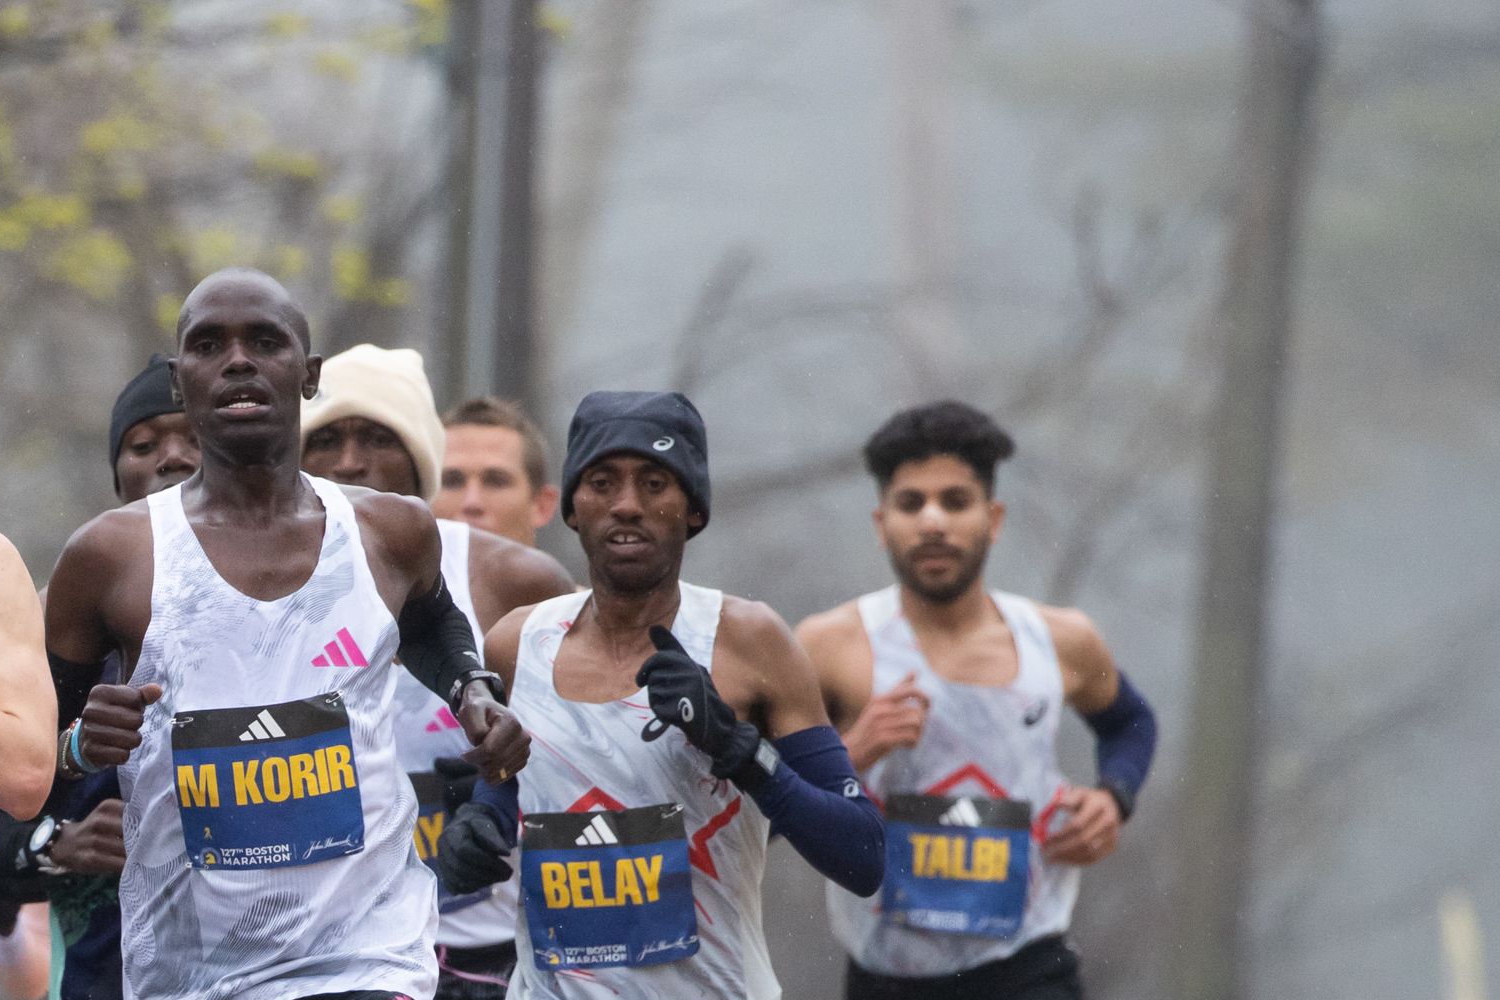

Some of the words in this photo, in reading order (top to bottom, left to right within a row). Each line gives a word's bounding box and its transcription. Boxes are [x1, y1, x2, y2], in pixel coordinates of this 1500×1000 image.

[177, 764, 220, 808] M
[232, 744, 356, 806] KORIR
[245, 844, 290, 856] BOSTON
[910, 832, 1010, 881] TALBI
[223, 852, 293, 866] MARATHON
[541, 855, 663, 909] BELAY
[586, 944, 627, 955] BOSTON
[566, 953, 628, 964] MARATHON
